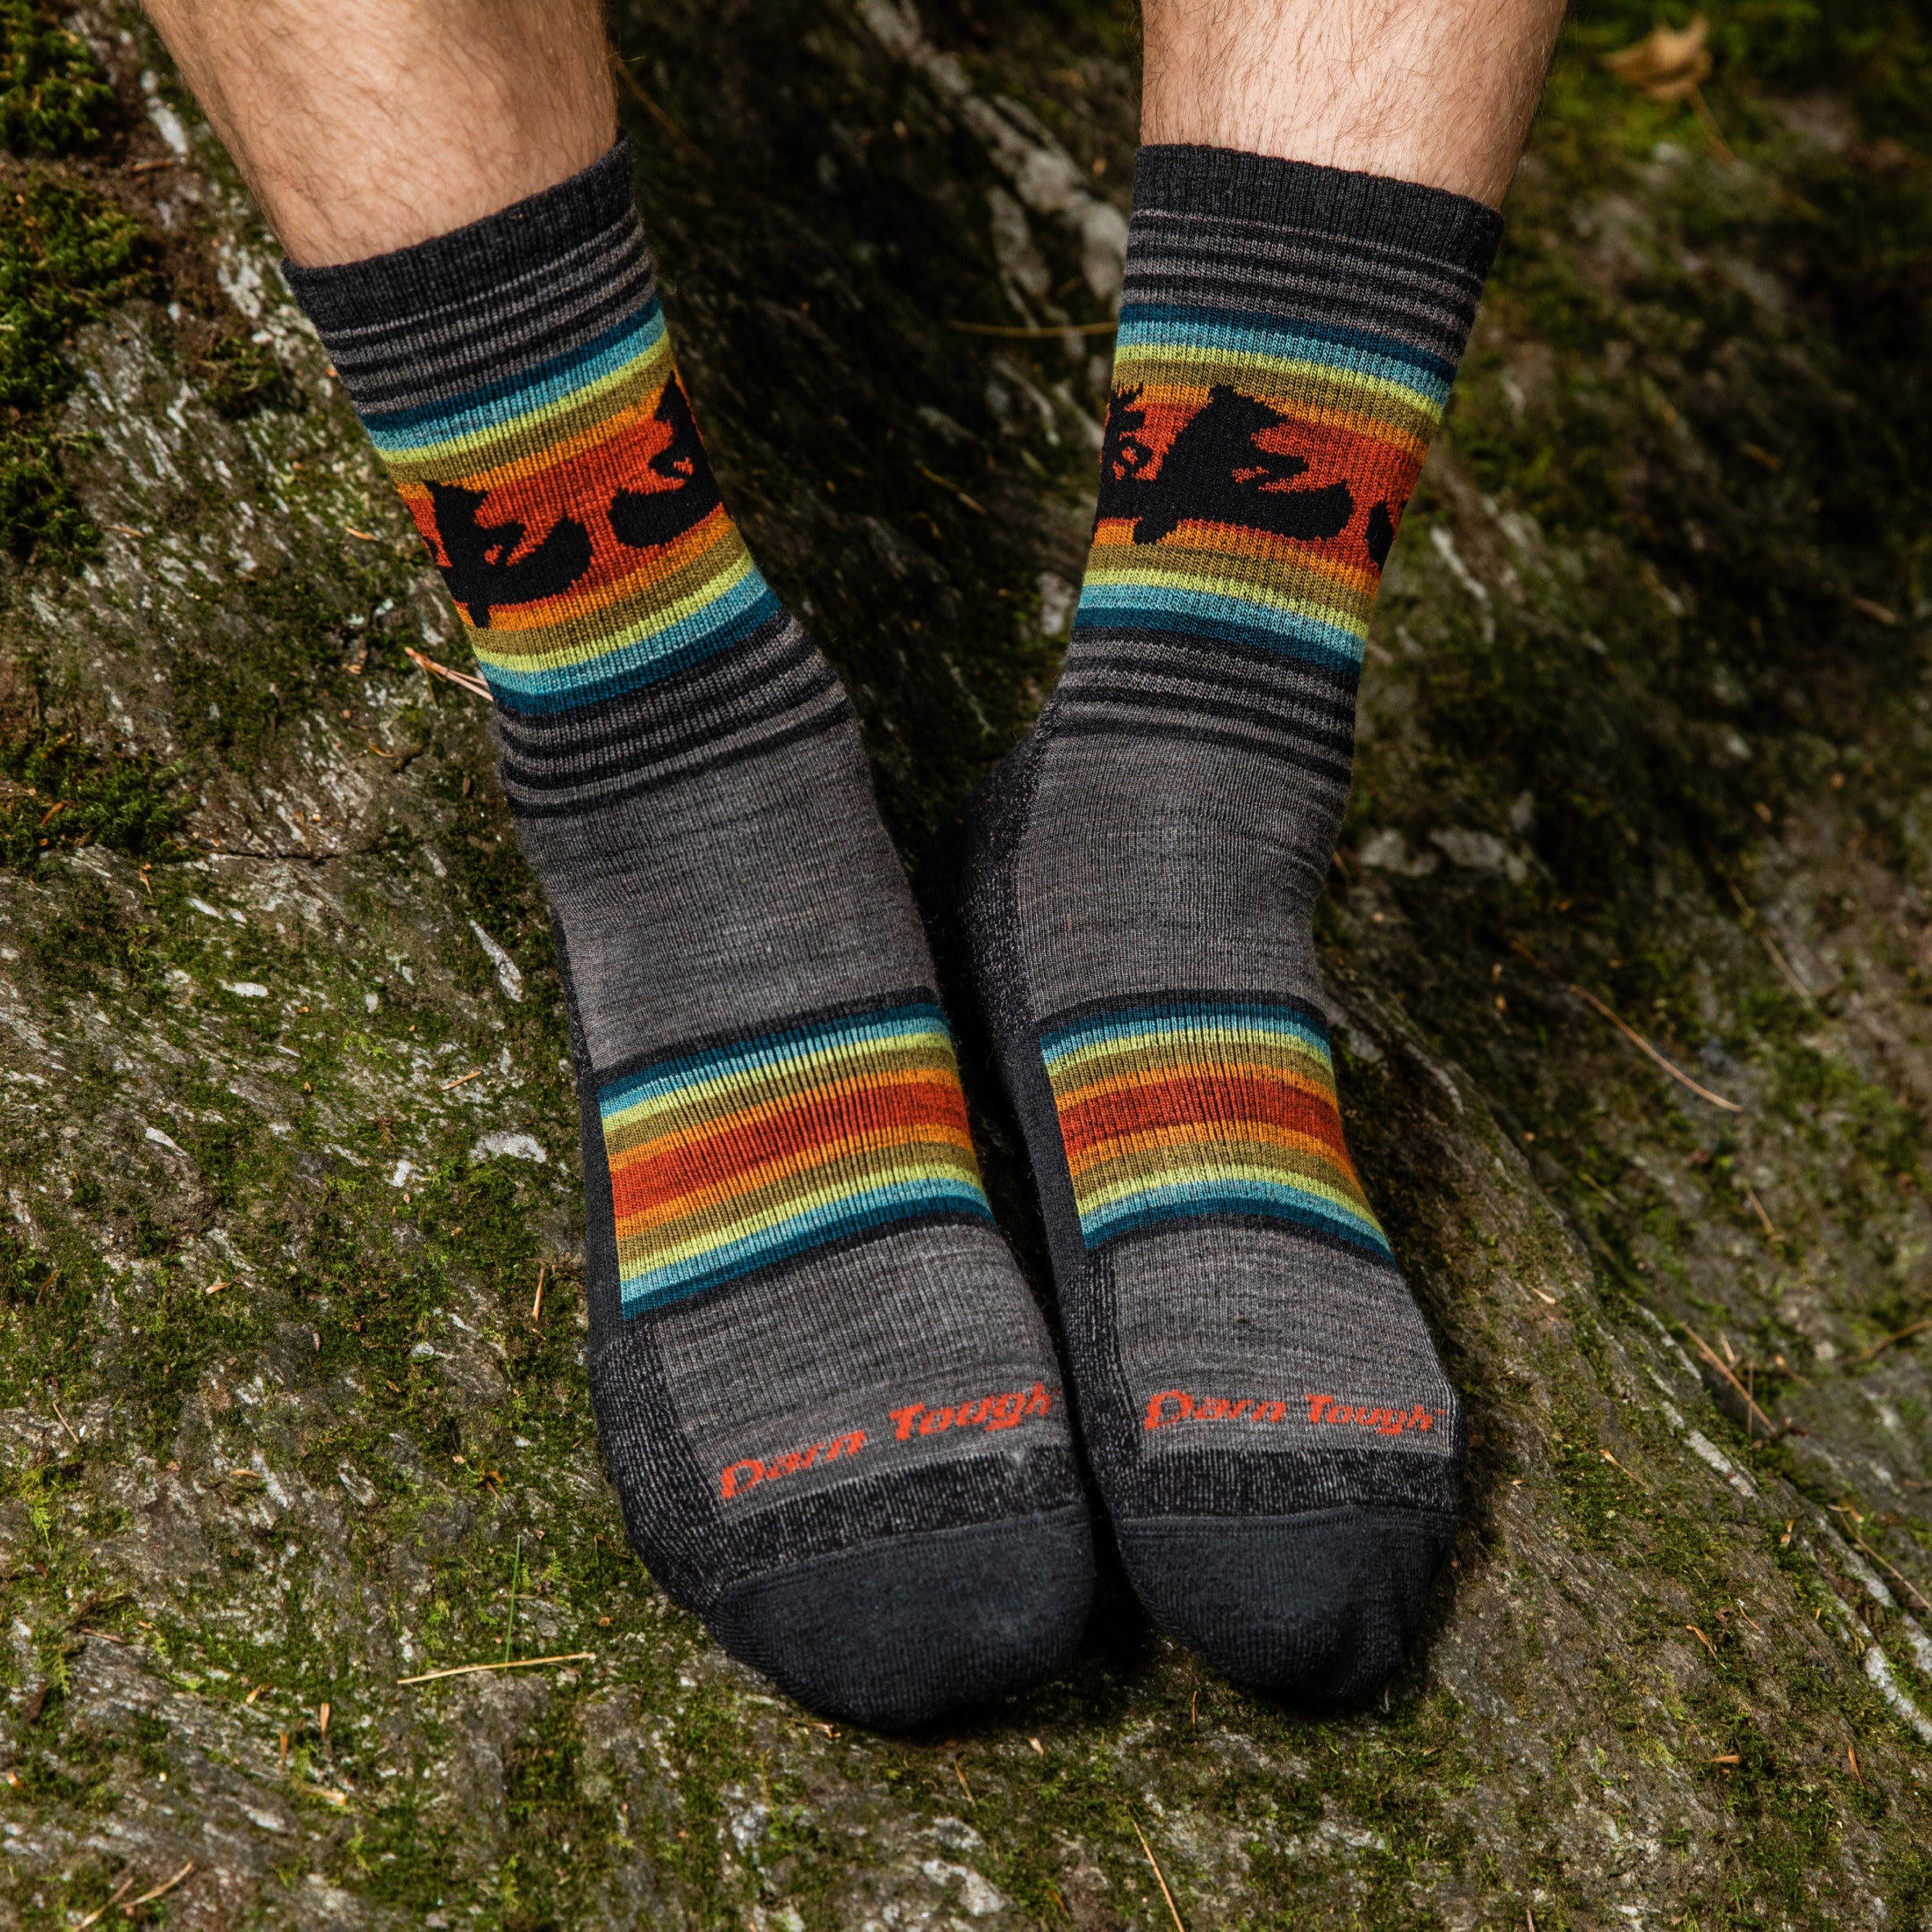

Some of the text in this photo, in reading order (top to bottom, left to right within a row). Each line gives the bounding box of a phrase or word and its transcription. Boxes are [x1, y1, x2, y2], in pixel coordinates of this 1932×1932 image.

[720, 1381, 1052, 1499] Darn Tough
[1145, 1389, 1434, 1436] Darn Tough
